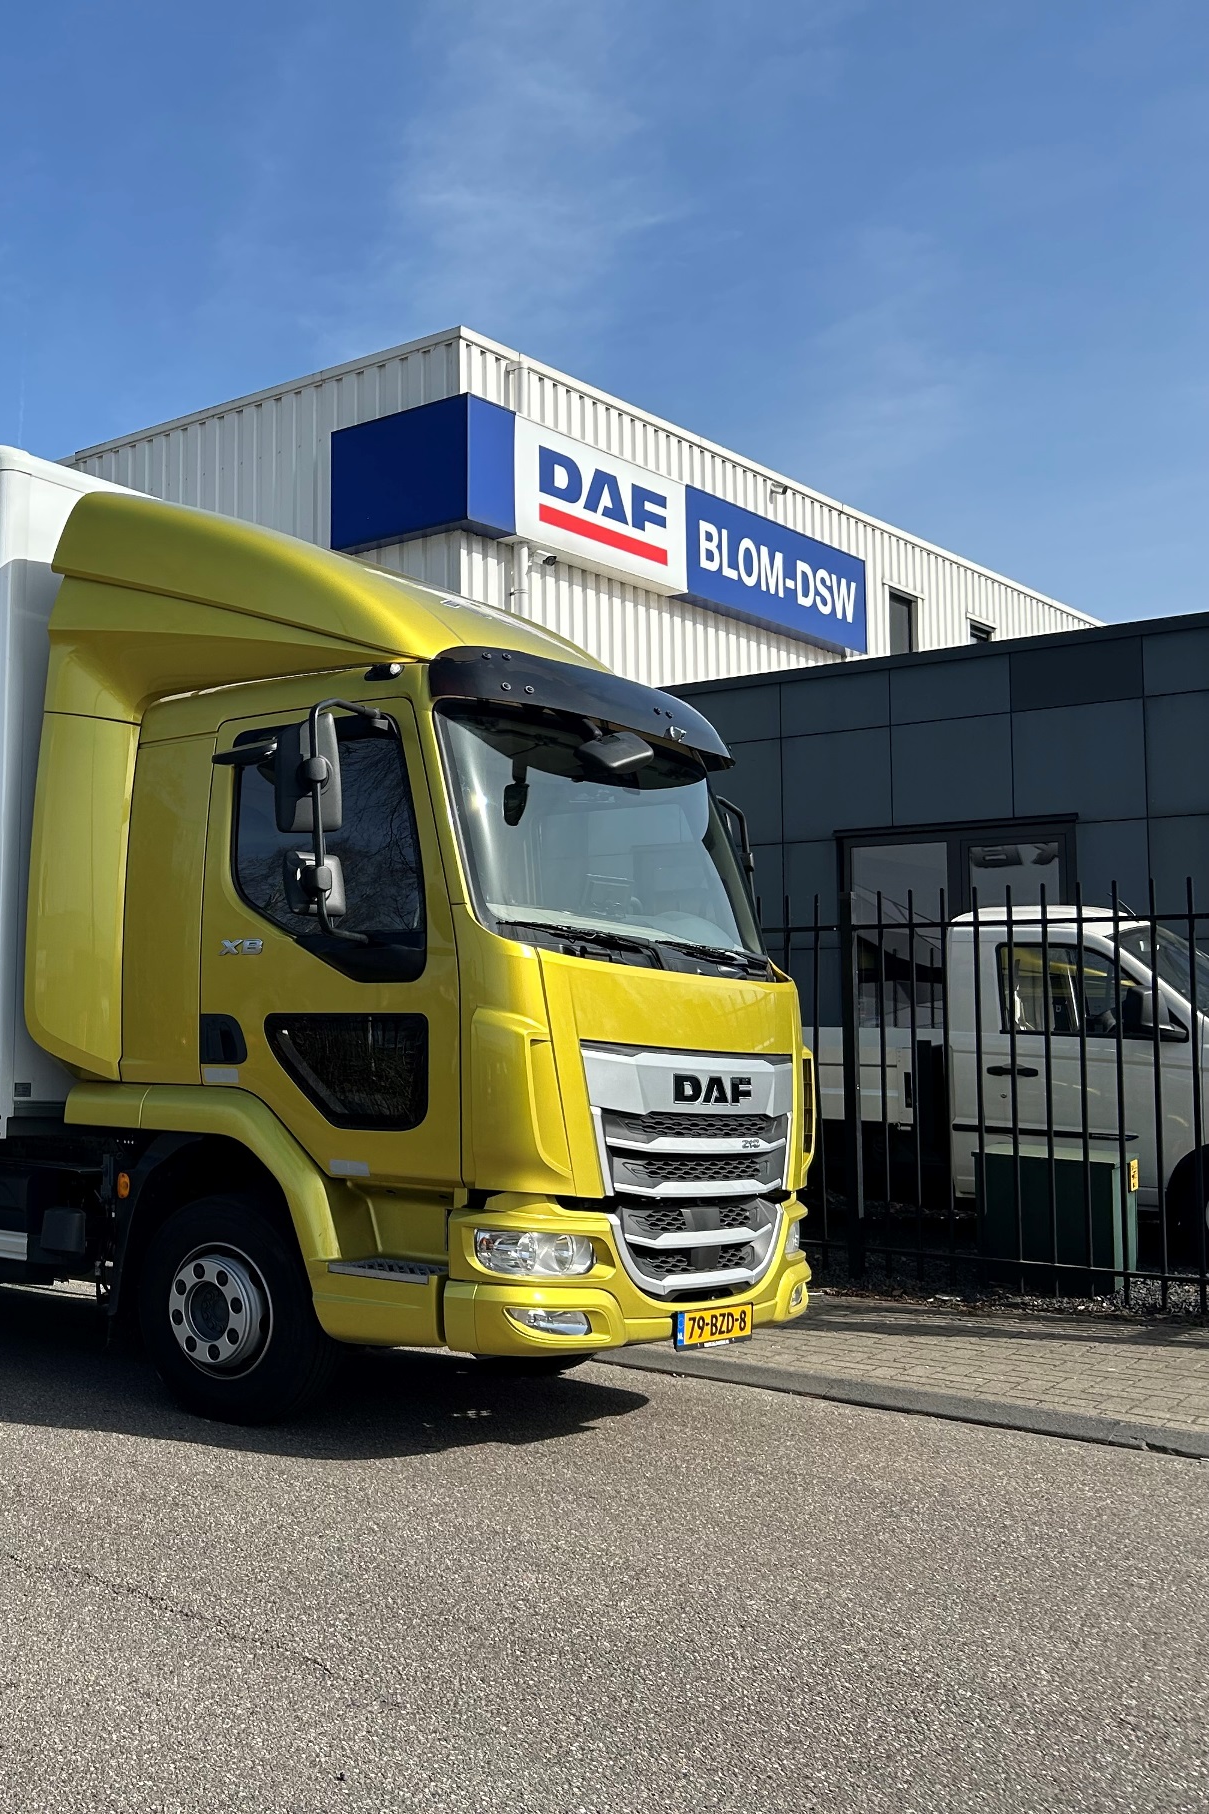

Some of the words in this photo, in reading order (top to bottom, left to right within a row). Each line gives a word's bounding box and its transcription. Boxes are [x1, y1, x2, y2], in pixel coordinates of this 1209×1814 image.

[538, 445, 668, 532] DAF
[698, 519, 857, 623] BLOM-DSW
[219, 938, 263, 956] XB
[672, 1072, 753, 1107] DAF
[688, 1309, 747, 1341] 79-BZD-8
